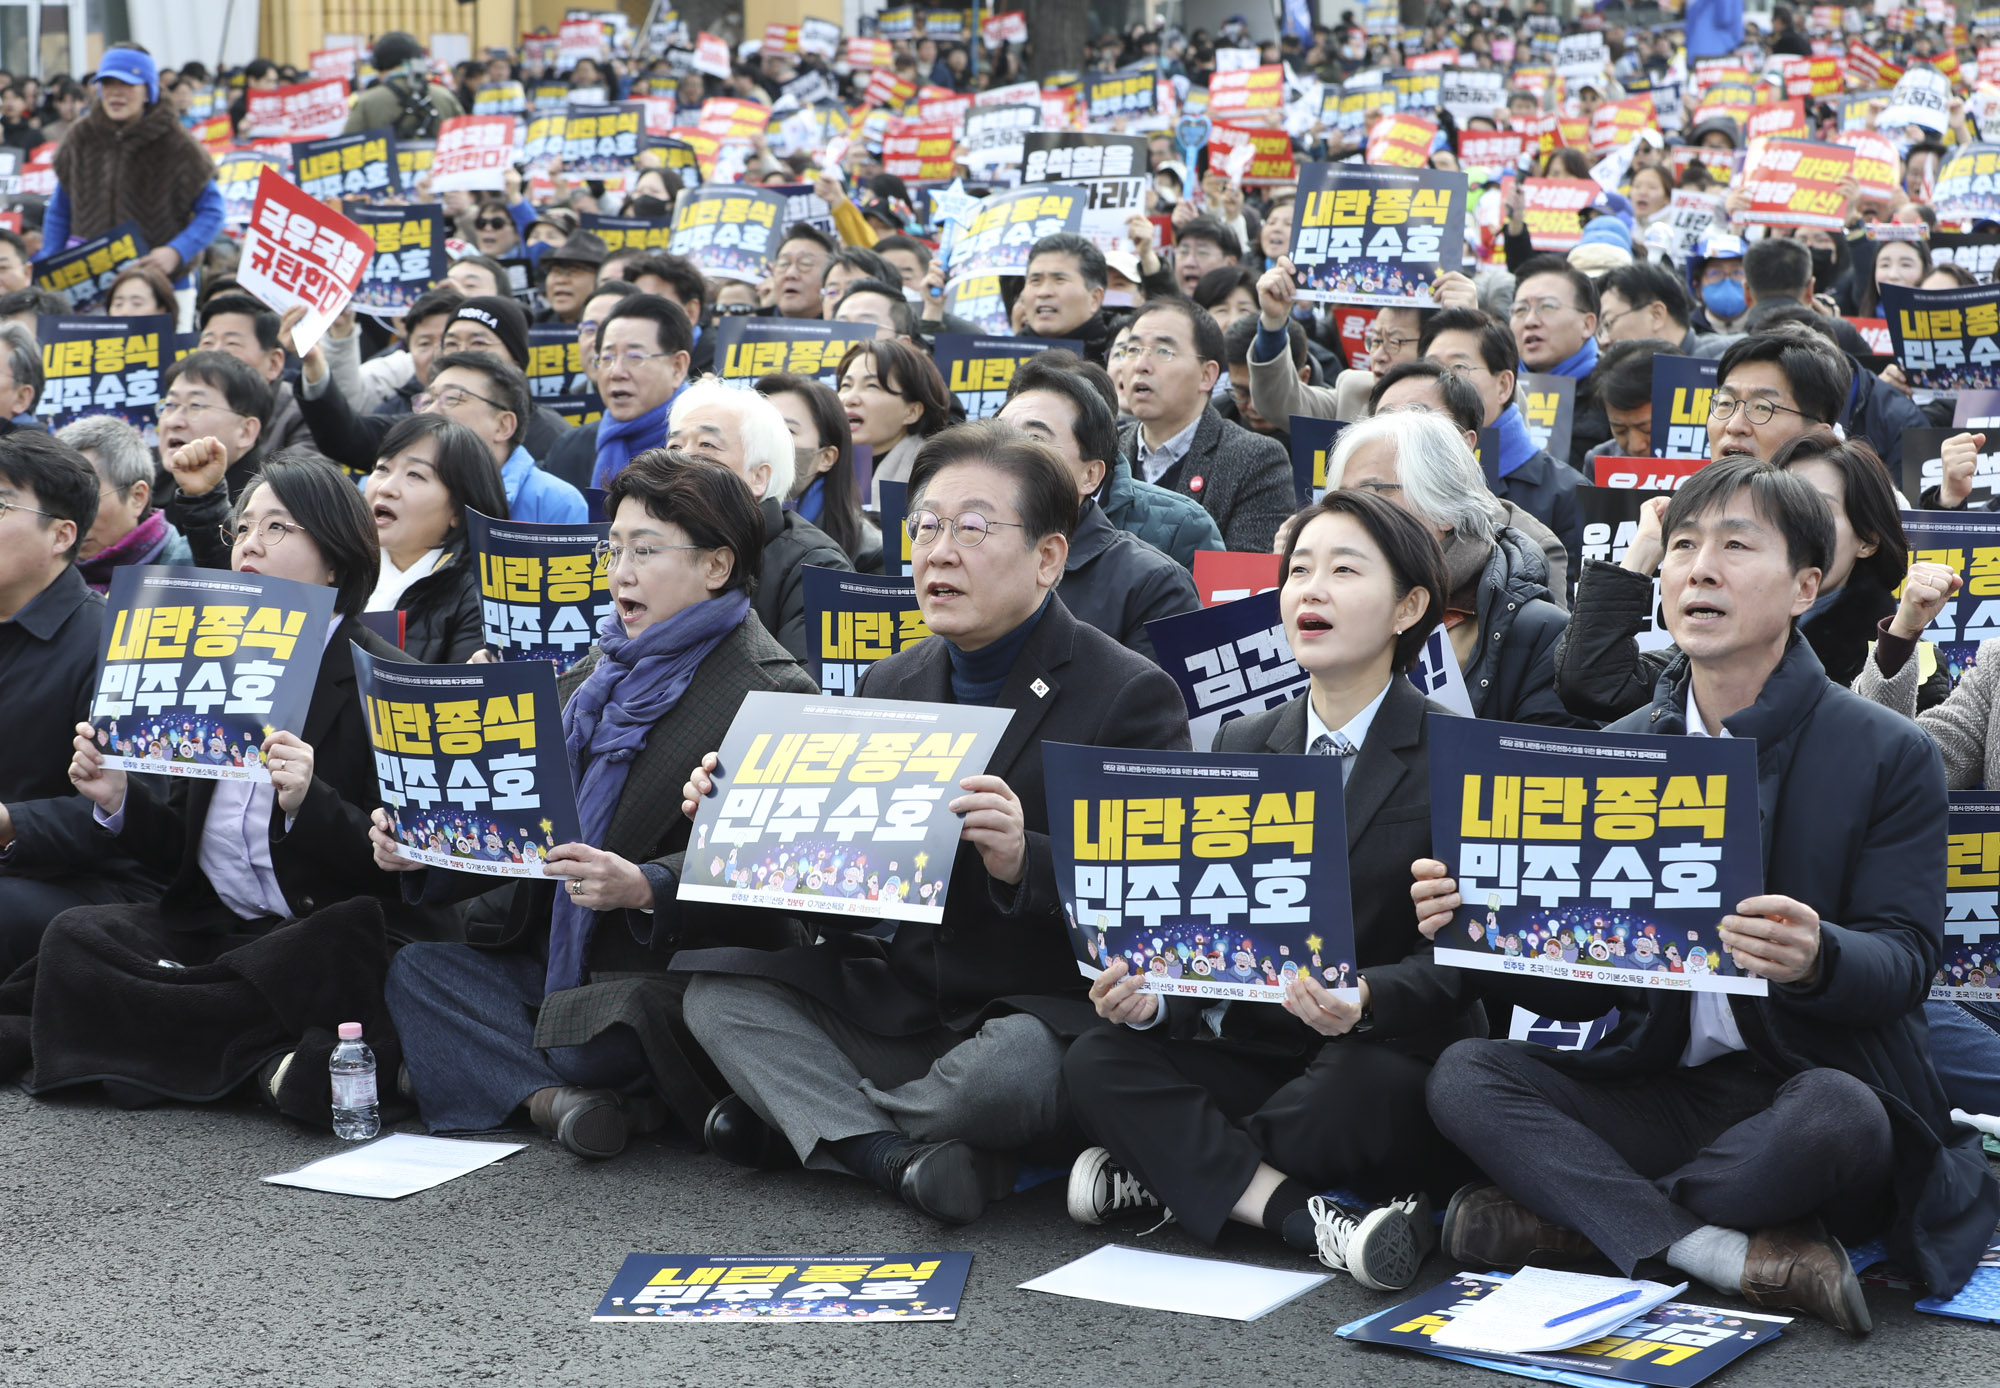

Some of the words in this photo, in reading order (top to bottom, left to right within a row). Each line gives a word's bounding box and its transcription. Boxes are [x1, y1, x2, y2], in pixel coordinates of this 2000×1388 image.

[1301, 189, 1372, 227] 내란
[1371, 188, 1452, 225] 종식
[1293, 227, 1365, 265] 민주
[1365, 225, 1445, 263] 수호
[457, 307, 498, 329] KOREA
[1899, 308, 1963, 340] 내란
[1965, 302, 2000, 338] 종
[42, 339, 94, 379] 내란
[94, 333, 159, 374] 종식
[723, 341, 787, 378] 내란
[1902, 340, 1966, 371] 민주
[1968, 336, 2000, 367] 수
[93, 369, 161, 410] 수호
[1527, 392, 1560, 427] 식
[1670, 387, 1714, 425] 내
[479, 551, 542, 603] 내란
[1968, 546, 2000, 596] 종
[106, 605, 196, 661] 내란
[192, 605, 307, 661] 종식
[483, 599, 542, 650] 민주
[821, 610, 894, 660] 내란
[92, 662, 183, 717] 민주
[182, 659, 286, 715] 수호
[1184, 624, 1310, 709] 김건
[366, 694, 432, 755] 내란
[434, 692, 536, 755] 종식
[374, 751, 442, 811] 민주
[445, 752, 540, 811] 수호
[732, 732, 861, 784] 내란
[847, 732, 978, 783] 종식
[709, 787, 831, 843] 민주
[822, 784, 945, 842] 수호
[1073, 797, 1186, 861] 내란
[1191, 790, 1315, 858] 종식
[1460, 774, 1588, 840] 내란
[1593, 774, 1728, 840] 종식
[1458, 843, 1581, 908] 민주
[1590, 842, 1723, 909] 수호
[1946, 831, 2000, 888] 란
[1074, 864, 1181, 927] 민주
[1190, 858, 1312, 925] 수호
[1944, 891, 2000, 944] 주
[1177, 984, 1198, 994] 진보당
[1207, 985, 1244, 997] 기본소득당
[1503, 960, 1526, 971] 민주당
[1571, 968, 1594, 979] 진보당
[1604, 972, 1644, 984] 기본소득당
[1930, 989, 1952, 998] 민주당
[629, 1283, 780, 1305] 민주
[781, 1280, 927, 1302] 수호
[646, 1265, 797, 1286] 내란
[797, 1260, 942, 1283] 종식
